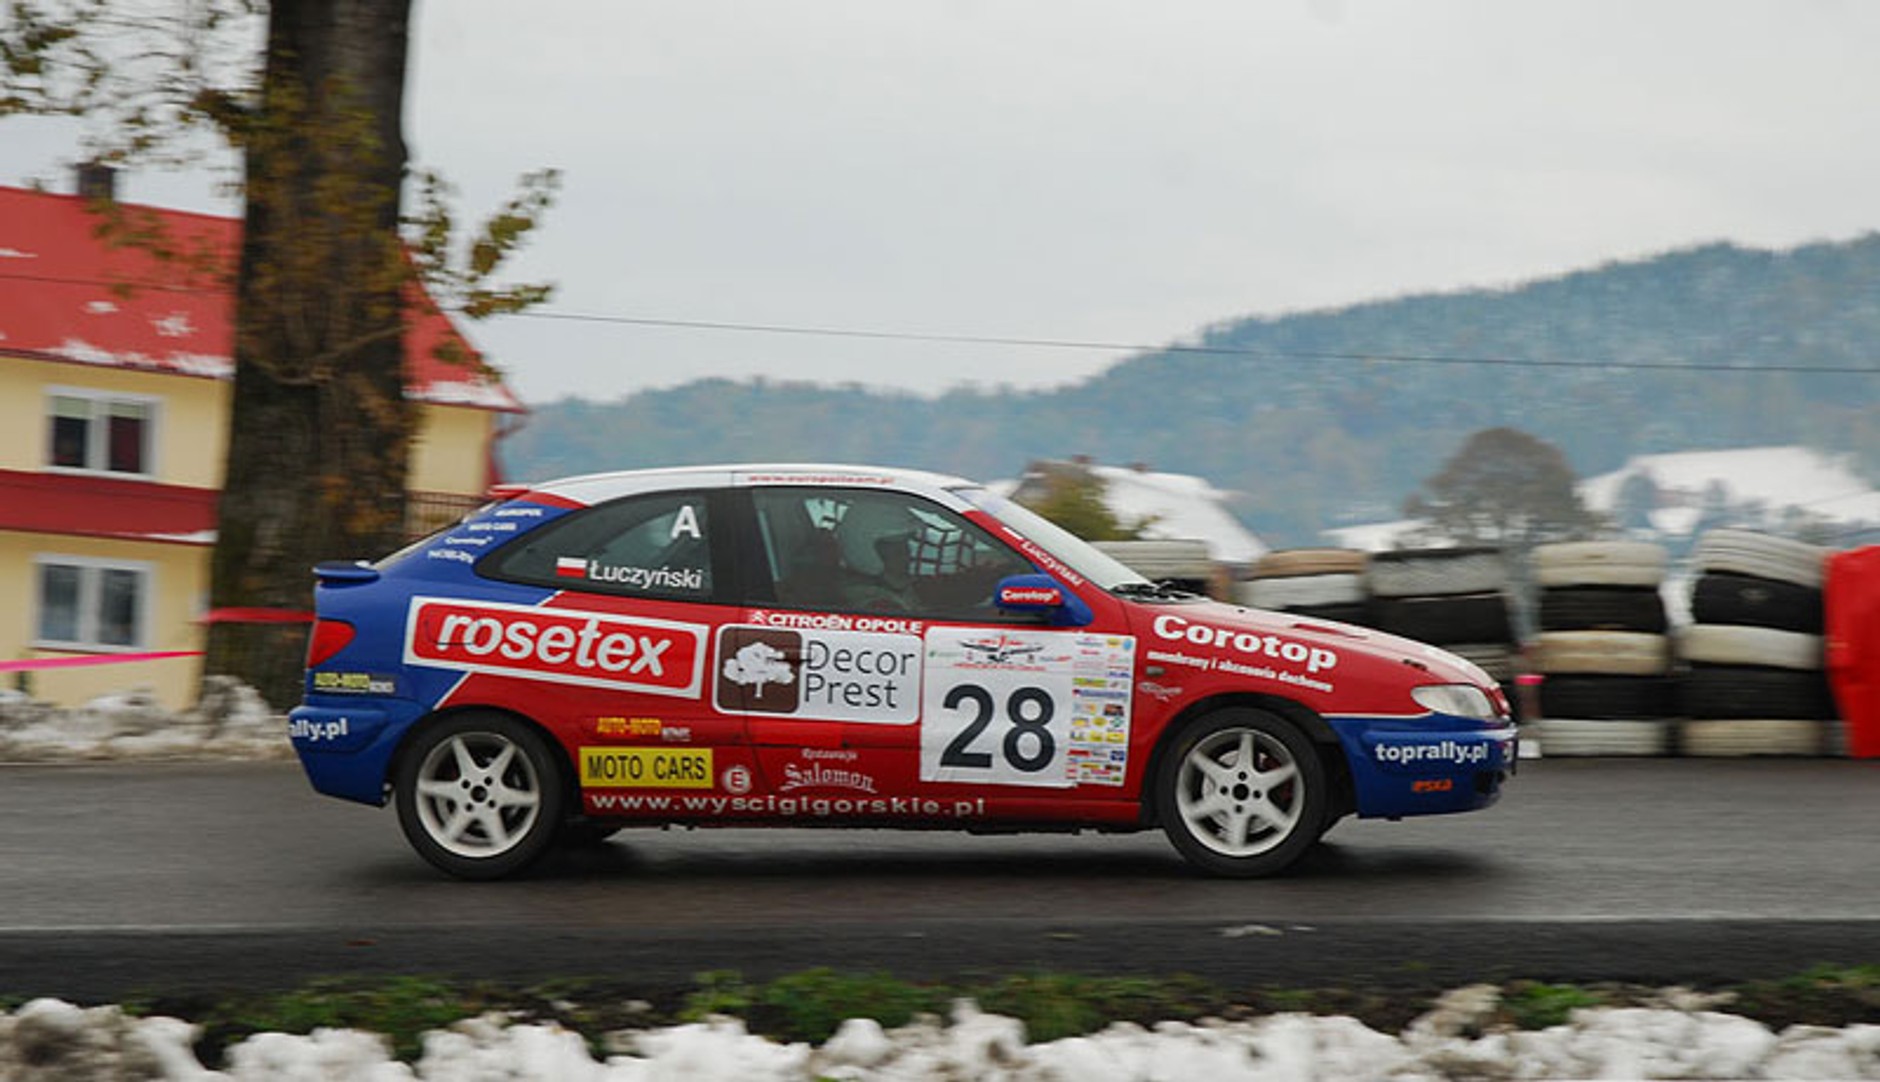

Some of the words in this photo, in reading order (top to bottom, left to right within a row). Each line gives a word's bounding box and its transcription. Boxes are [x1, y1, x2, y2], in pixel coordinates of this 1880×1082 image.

[671, 505, 701, 538] A
[589, 560, 703, 590] Łuczyński
[855, 618, 923, 634] OPOLE
[436, 613, 672, 677] rosetex
[806, 640, 915, 676] Decor
[1153, 615, 1337, 673] Corotop
[805, 673, 897, 709] Prest
[940, 684, 1056, 773] 28
[587, 755, 643, 780] MOTO
[654, 755, 706, 780] CARS
[1375, 740, 1489, 765] toprally.pl
